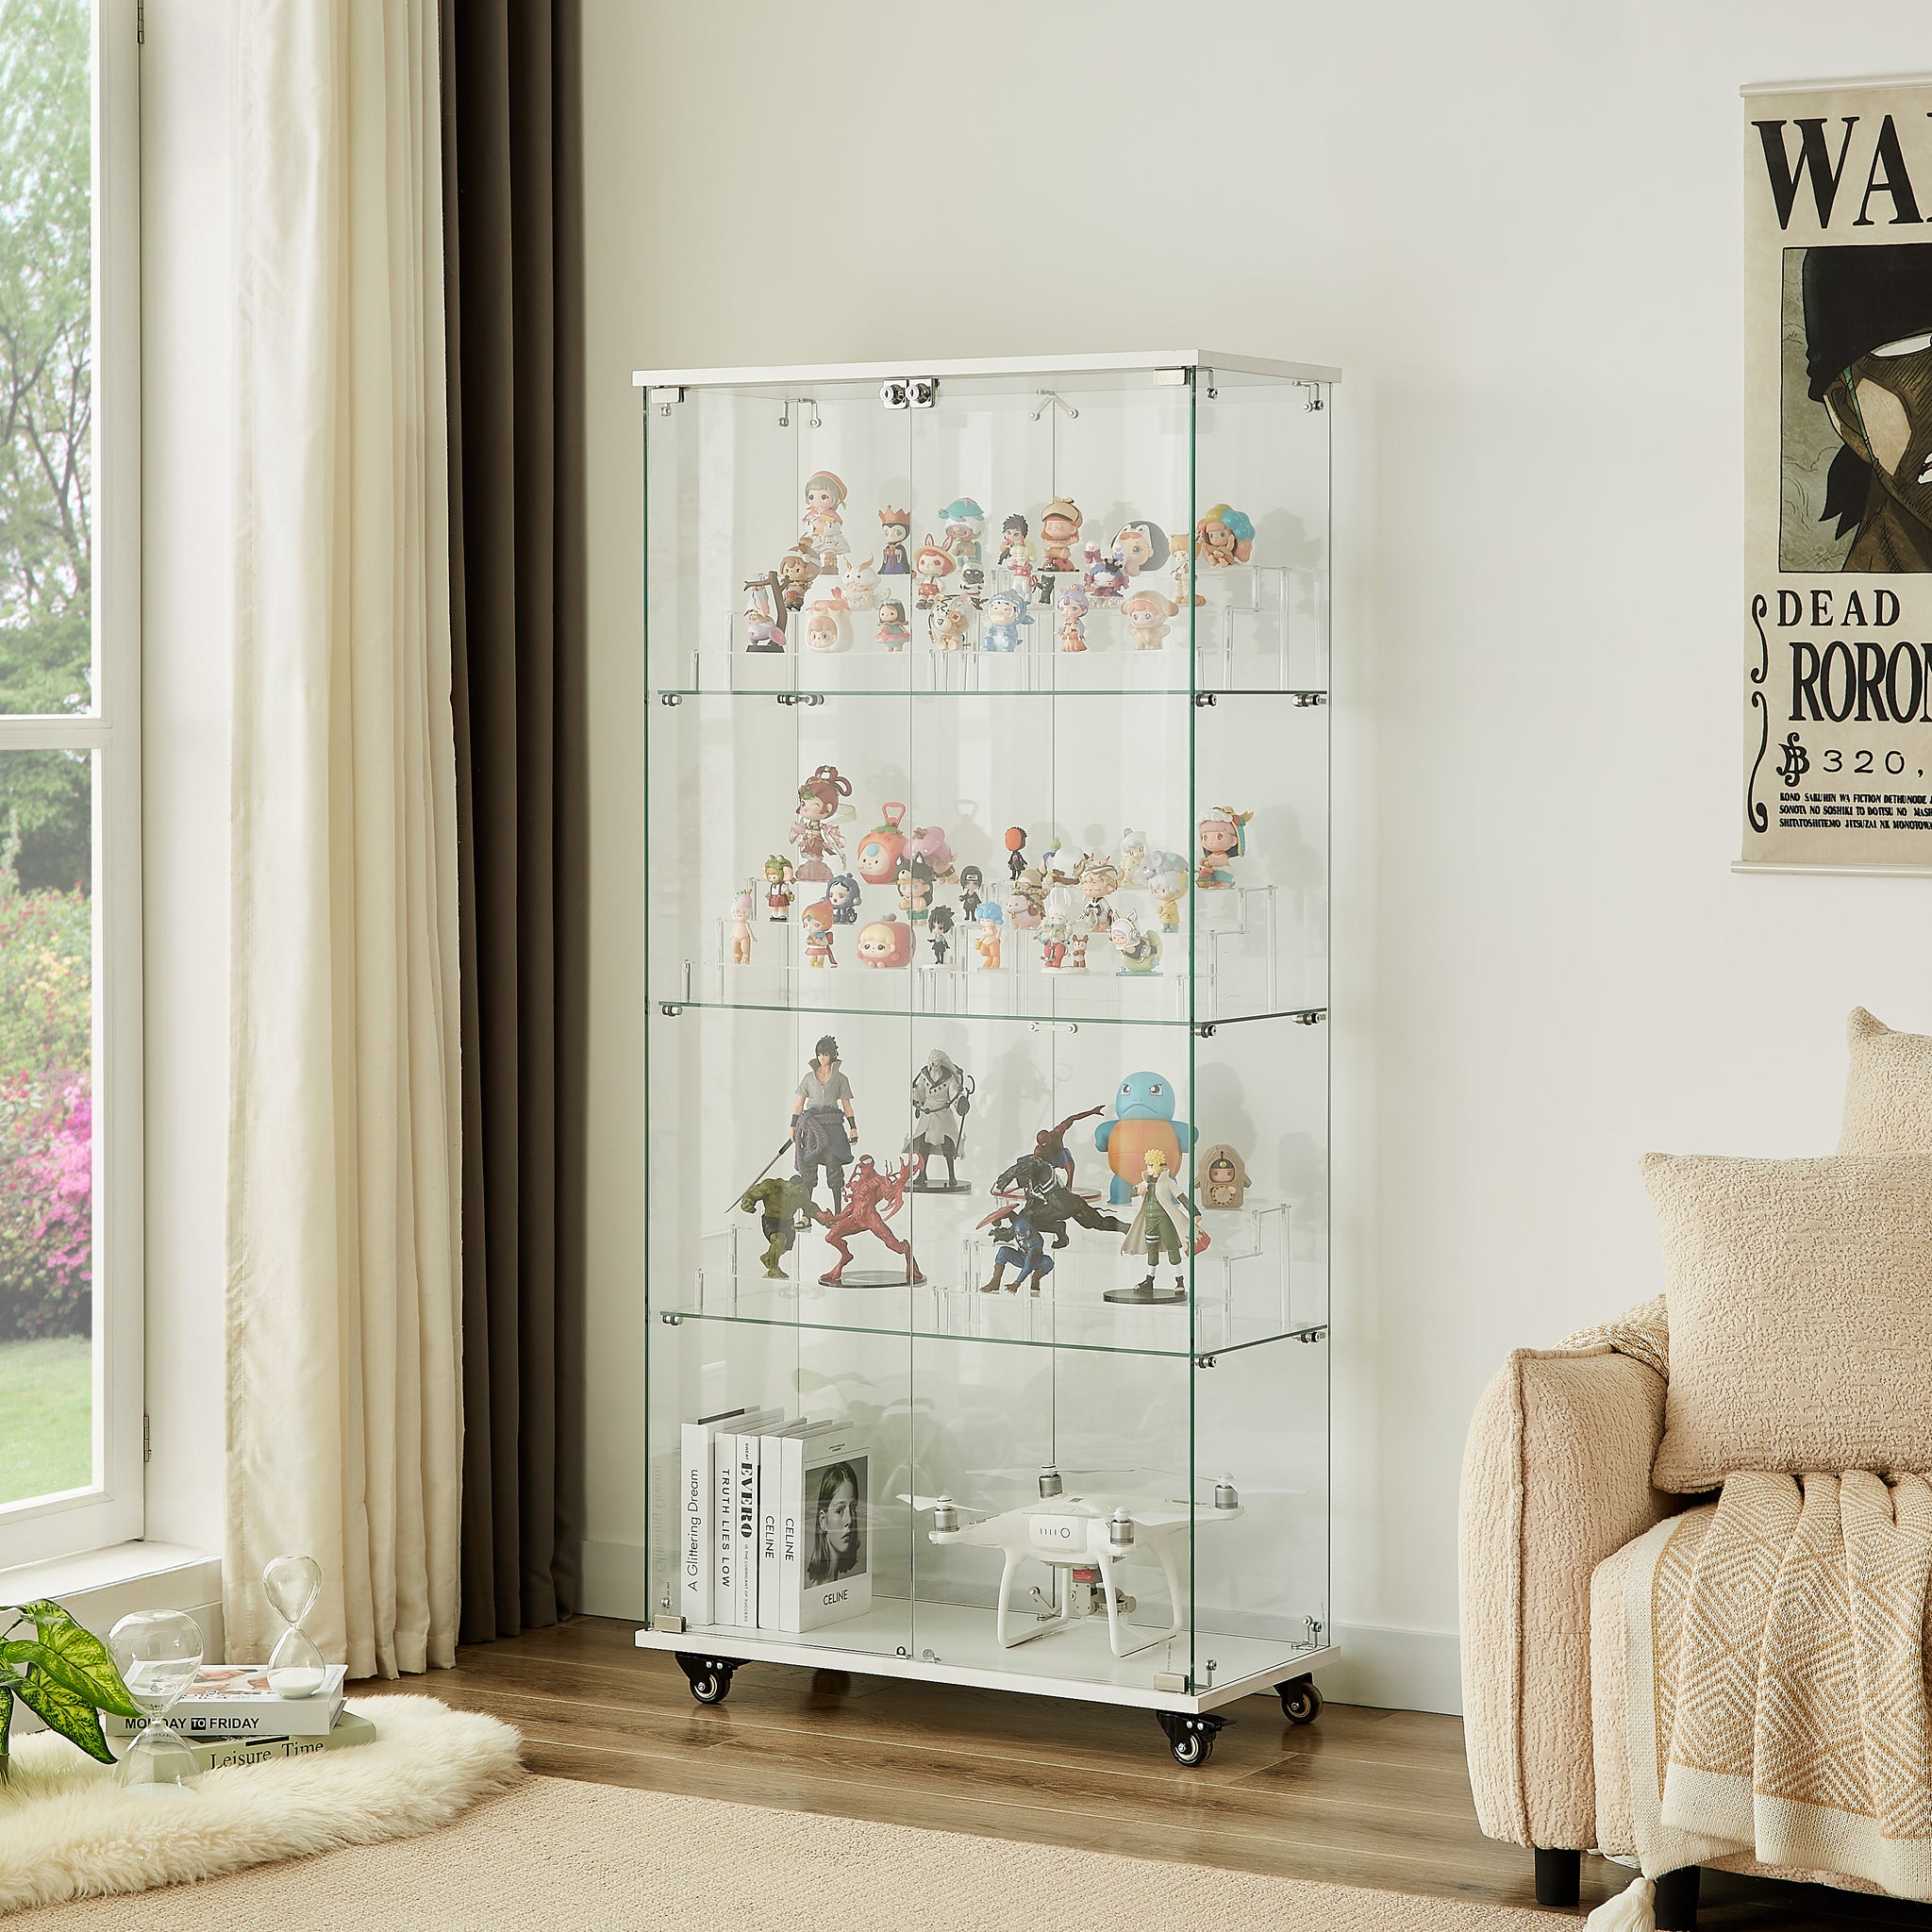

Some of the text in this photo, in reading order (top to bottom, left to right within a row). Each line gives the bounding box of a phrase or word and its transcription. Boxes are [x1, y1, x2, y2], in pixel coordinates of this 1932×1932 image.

[1751, 112, 1932, 230] WA
[1777, 590, 1901, 626] DEAD
[1779, 792, 1801, 802] KONO
[1840, 793, 1850, 803] WA
[1853, 793, 1881, 804] FICTION
[1809, 806, 1821, 815] NO
[1823, 806, 1853, 815] SOSHIKI
[1856, 807, 1865, 815] TO
[1896, 808, 1907, 816] NO
[1844, 819, 1876, 829] JITSUZAI
[741, 1462, 753, 1539] EVERO
[686, 1469, 702, 1591] A Glittering Dream
[722, 1469, 730, 1588] TRUTH LIES LOW
[765, 1515, 775, 1559] CELINE
[785, 1518, 794, 1561] CELINE
[823, 1590, 848, 1606] CELINE
[192, 1718, 206, 1728] TO
[209, 1718, 260, 1729] FRIDAY
[209, 1741, 325, 1770] Leisure Time
